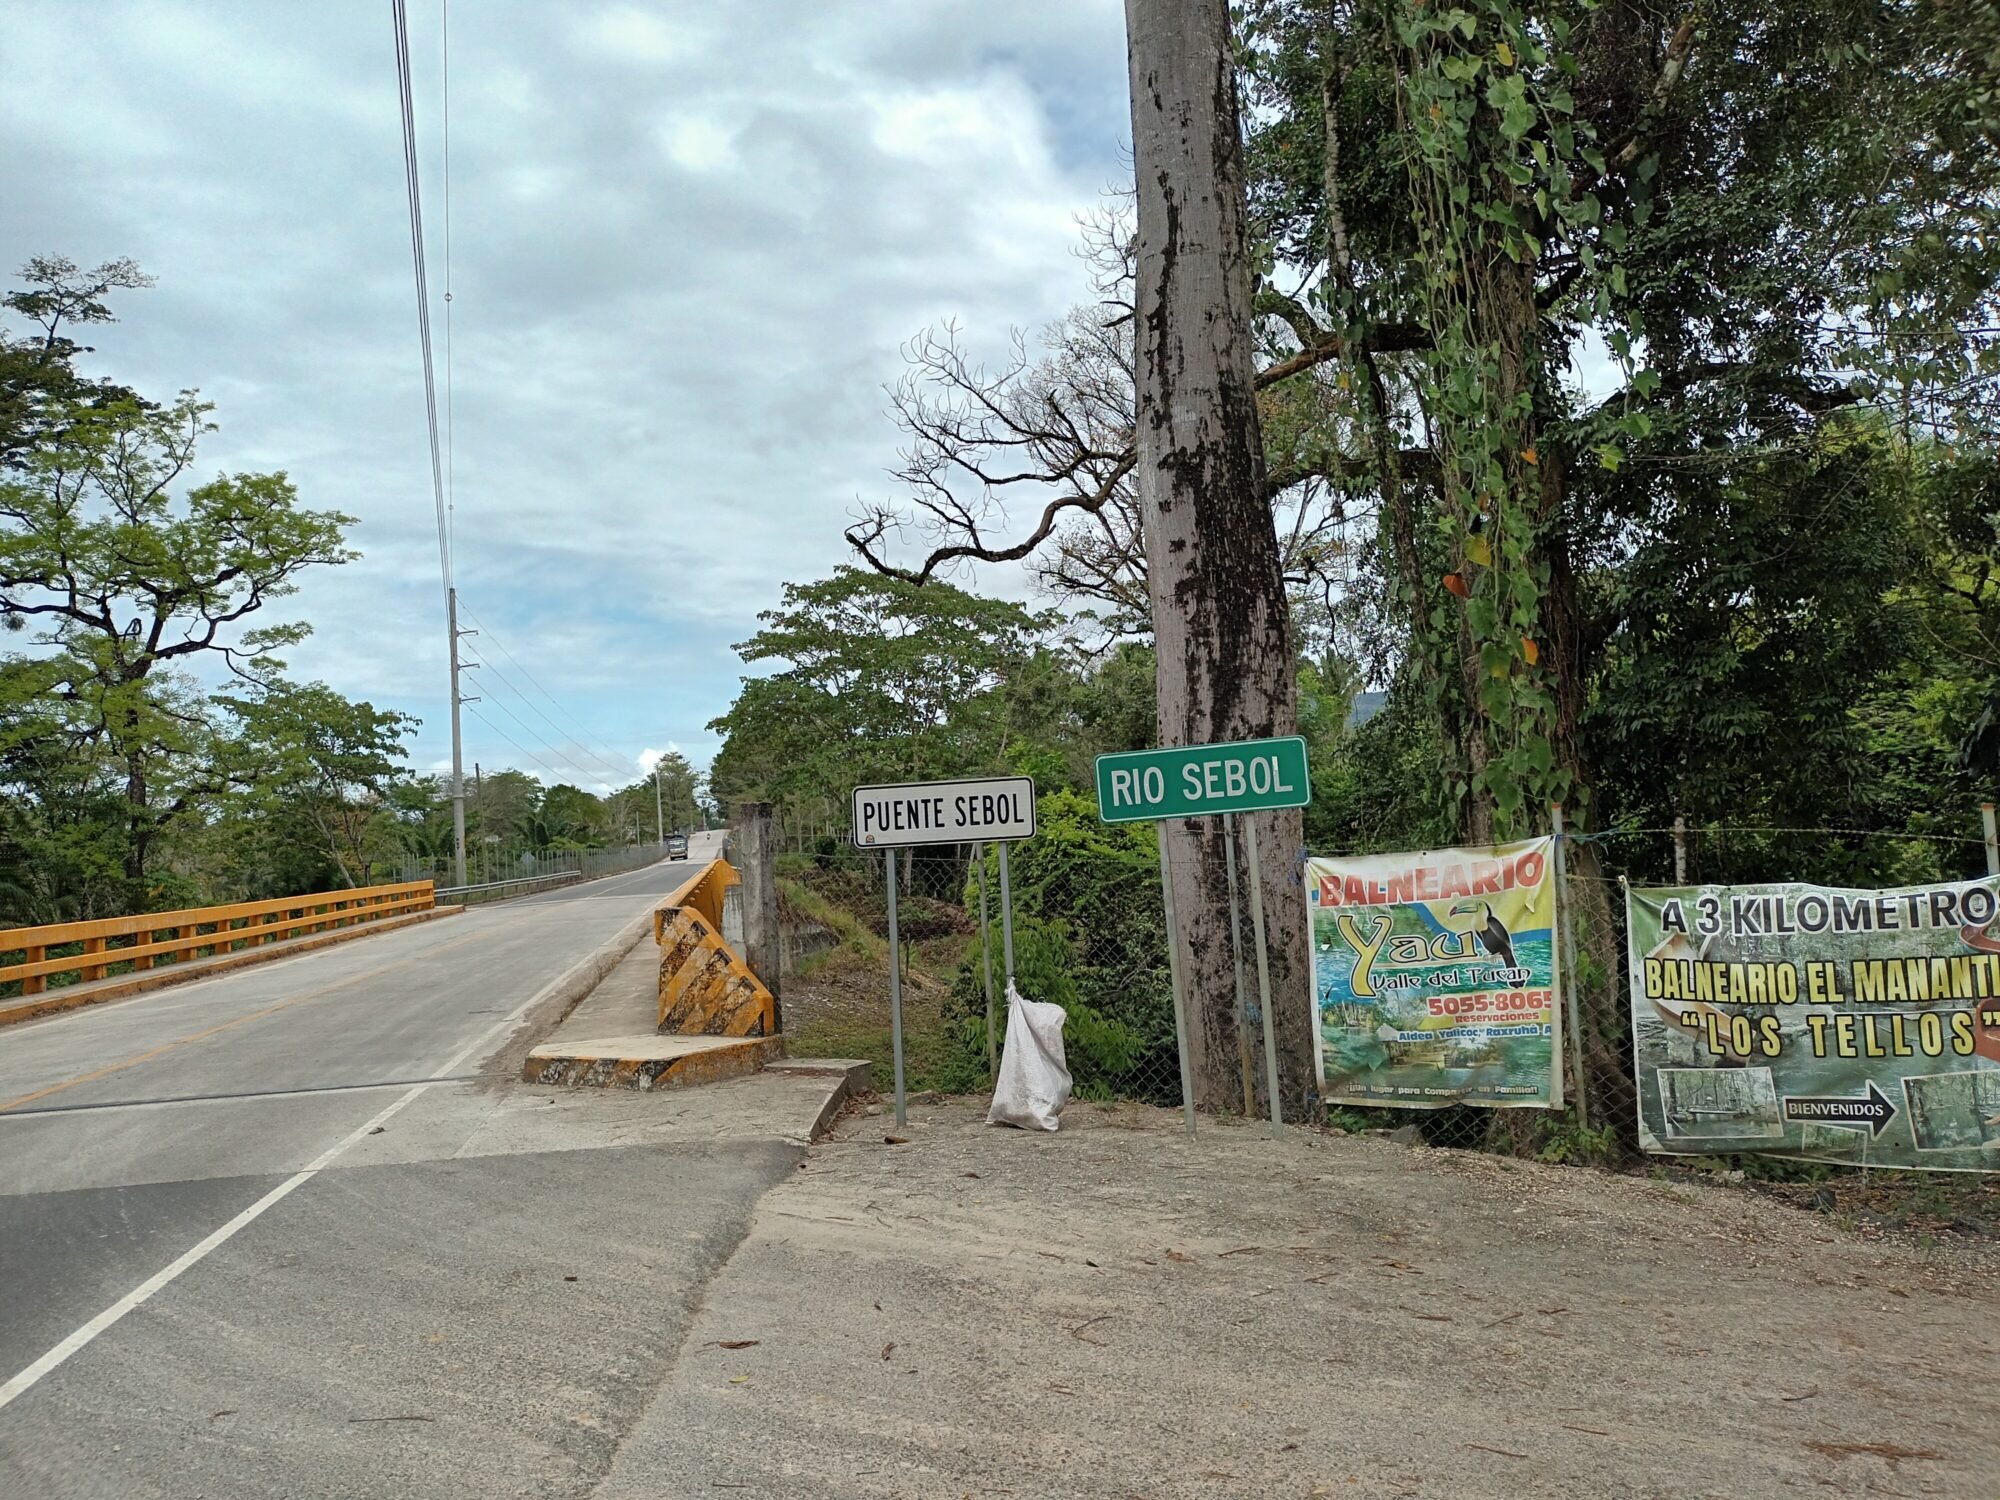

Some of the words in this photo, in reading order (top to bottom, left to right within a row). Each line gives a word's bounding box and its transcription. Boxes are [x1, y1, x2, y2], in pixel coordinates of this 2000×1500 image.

[1111, 766, 1165, 807] RIO
[1182, 756, 1294, 801] SEBOL
[863, 797, 945, 833] PUENTE
[955, 793, 1025, 827] SEBOL
[1319, 851, 1544, 908] BALNEARIO
[1660, 897, 1687, 933] A
[1697, 896, 1721, 934] 3
[1731, 886, 2000, 935] KILOMETRO
[1337, 914, 1479, 998] Yau
[1372, 973, 1420, 991] Valle
[1429, 970, 1459, 987] del
[1466, 967, 1531, 984] Tucan
[1644, 957, 1798, 1004] BALNEARIO
[1805, 961, 1844, 1003] EL
[1428, 991, 1552, 1016] 5055-8065
[1455, 1012, 1539, 1024] Reservaciones
[1398, 1031, 1433, 1041] Aldea
[1370, 1084, 1394, 1094] lugar
[1398, 1086, 1420, 1095] para
[1788, 1102, 1885, 1117] BIENVENIDOS
